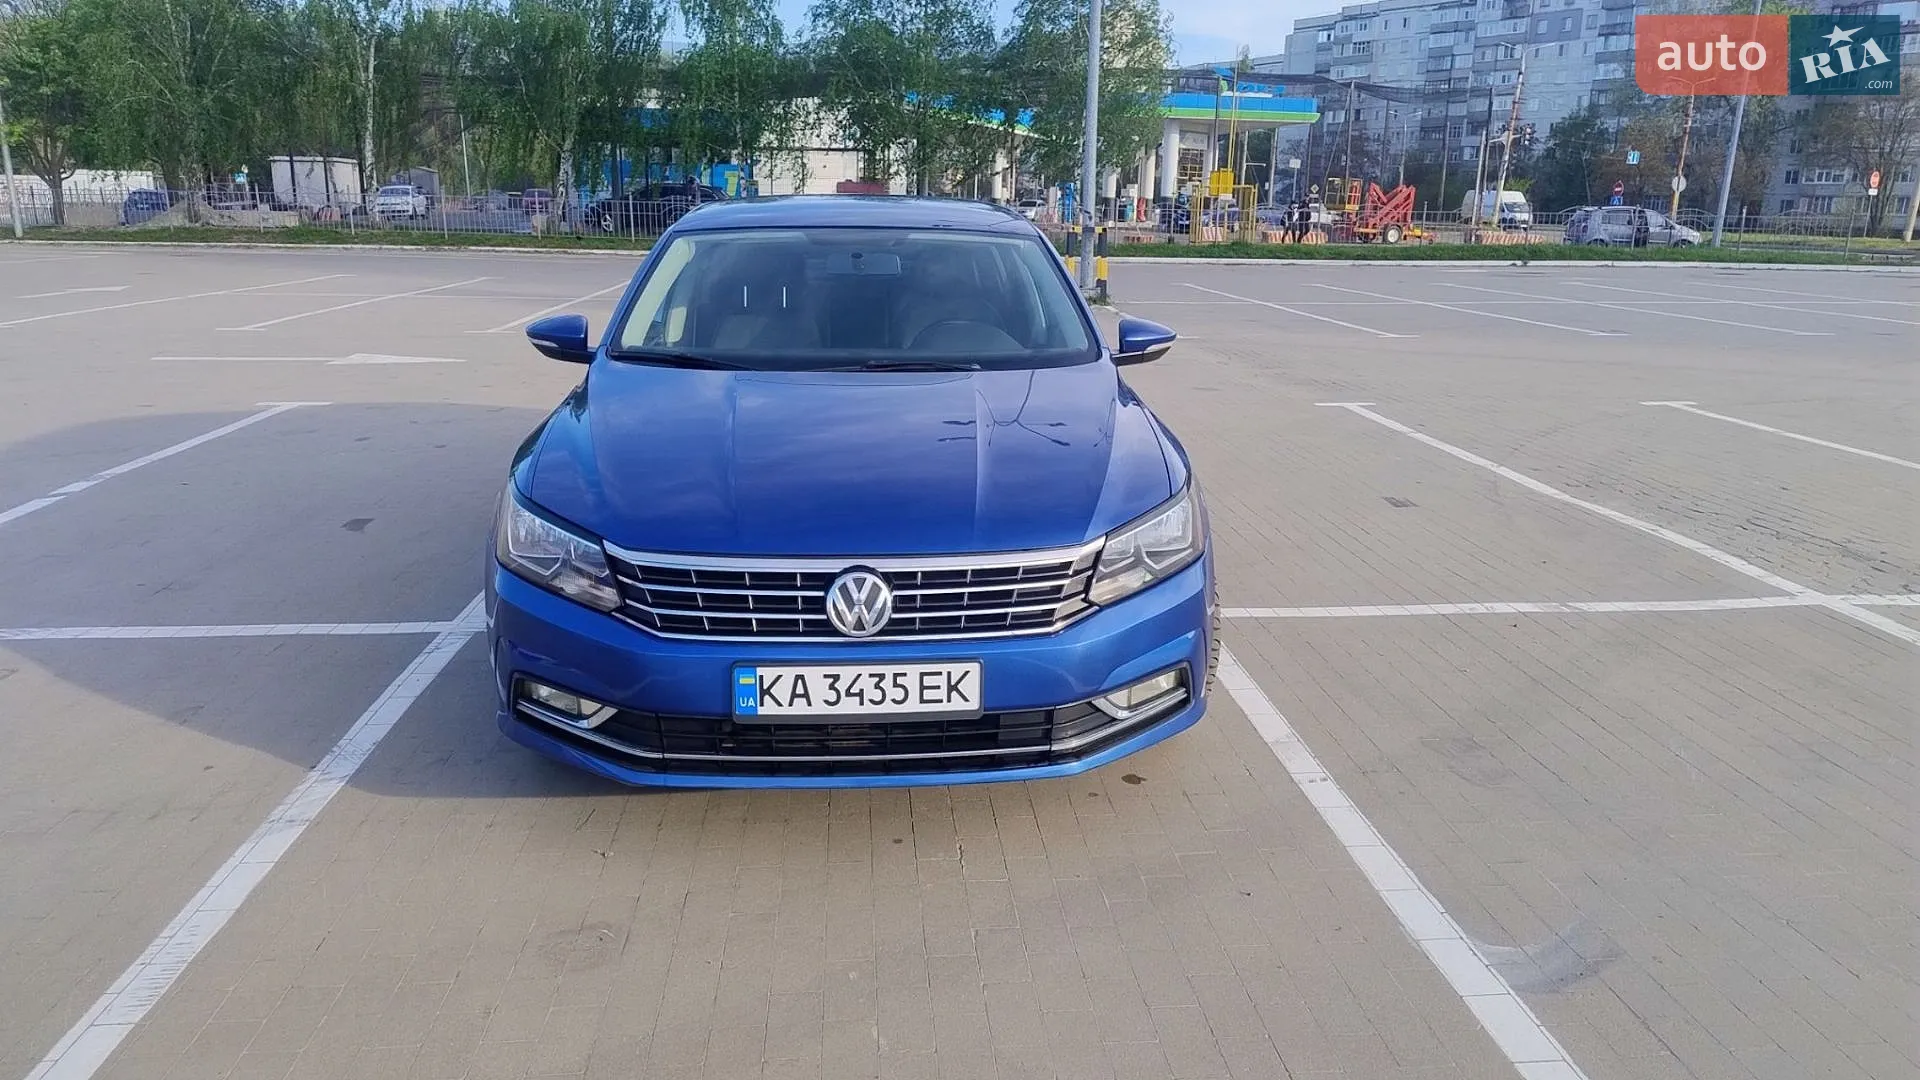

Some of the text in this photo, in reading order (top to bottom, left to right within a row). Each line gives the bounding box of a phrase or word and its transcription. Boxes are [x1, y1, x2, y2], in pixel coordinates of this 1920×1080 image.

[759, 670, 971, 707] KA 3435 EK
[740, 697, 755, 707] UA
